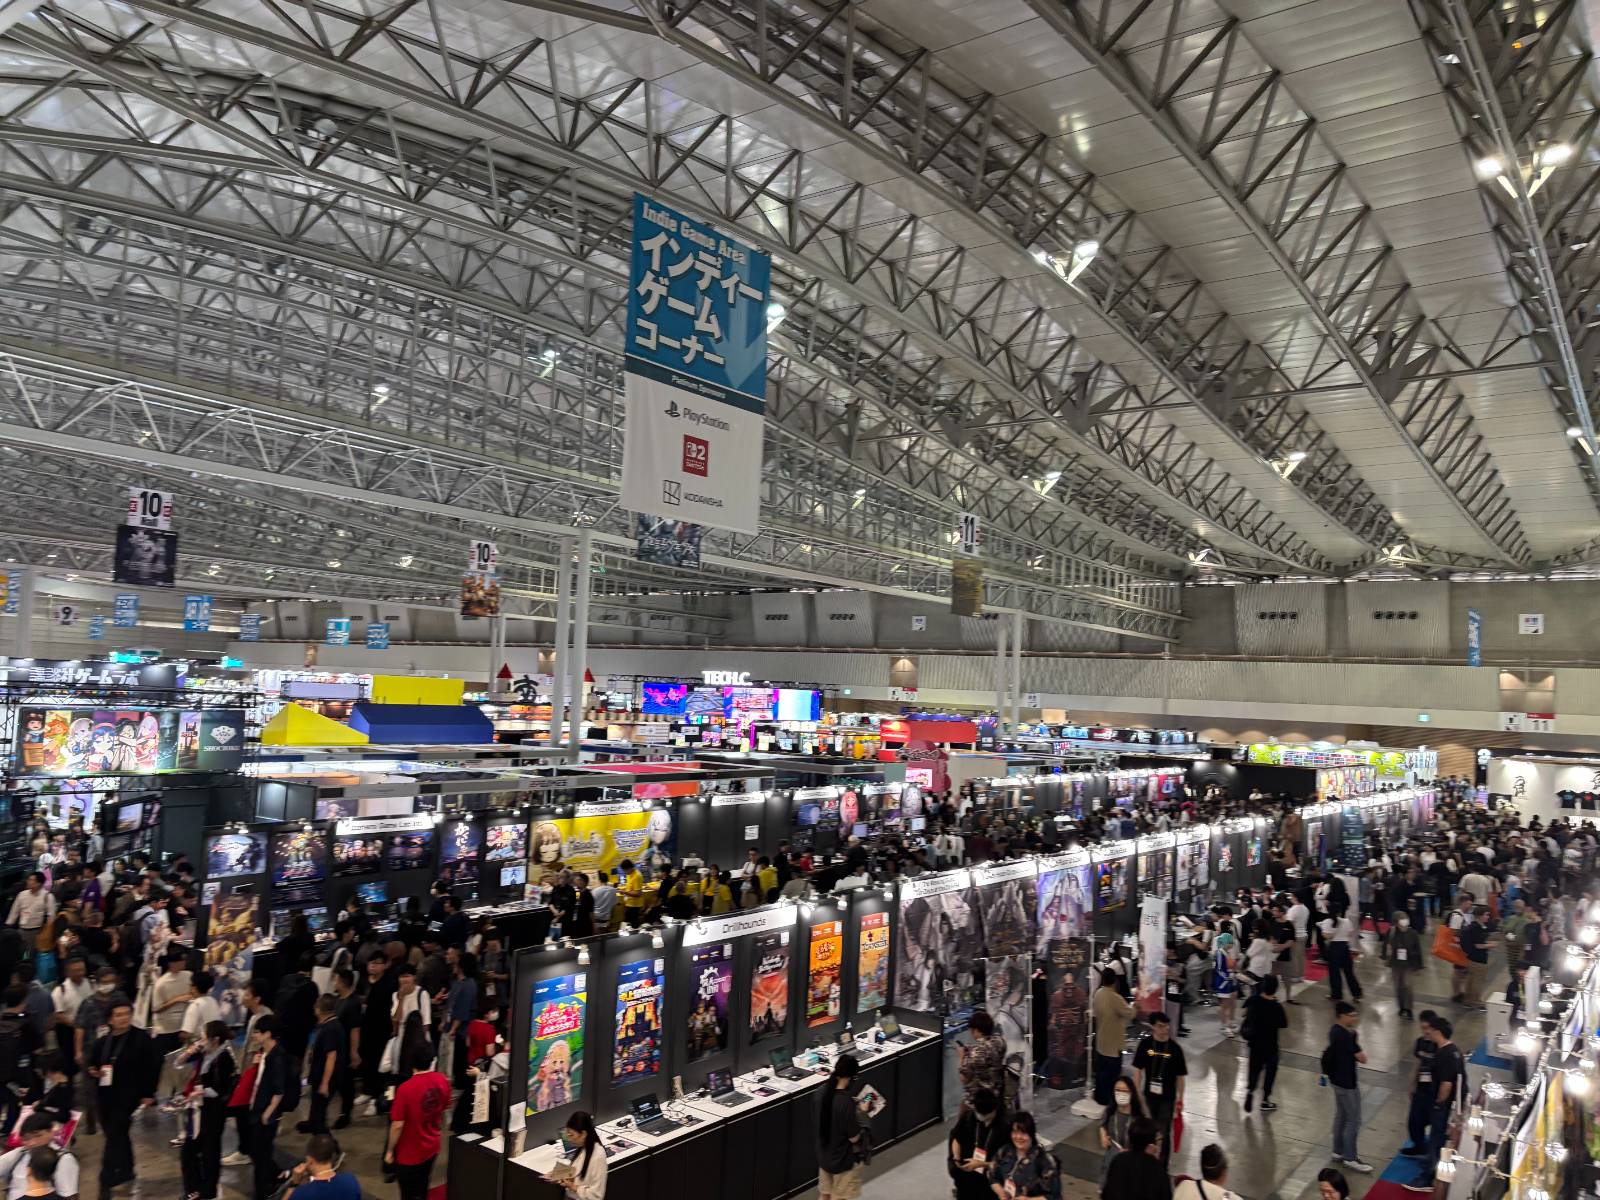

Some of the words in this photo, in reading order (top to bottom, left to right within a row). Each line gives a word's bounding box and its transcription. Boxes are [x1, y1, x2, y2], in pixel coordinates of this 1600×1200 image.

[643, 202, 677, 232] Indie
[681, 221, 716, 250] Game
[719, 240, 747, 264] Area
[641, 231, 763, 304] インディー
[636, 270, 722, 339] ゲーム
[635, 317, 725, 364] コーナー
[683, 407, 730, 431] PlayStation
[140, 491, 162, 517] 10
[963, 515, 975, 543] 11
[477, 543, 490, 563] 10
[61, 606, 73, 621] 9
[722, 919, 767, 934] Drillhounds
